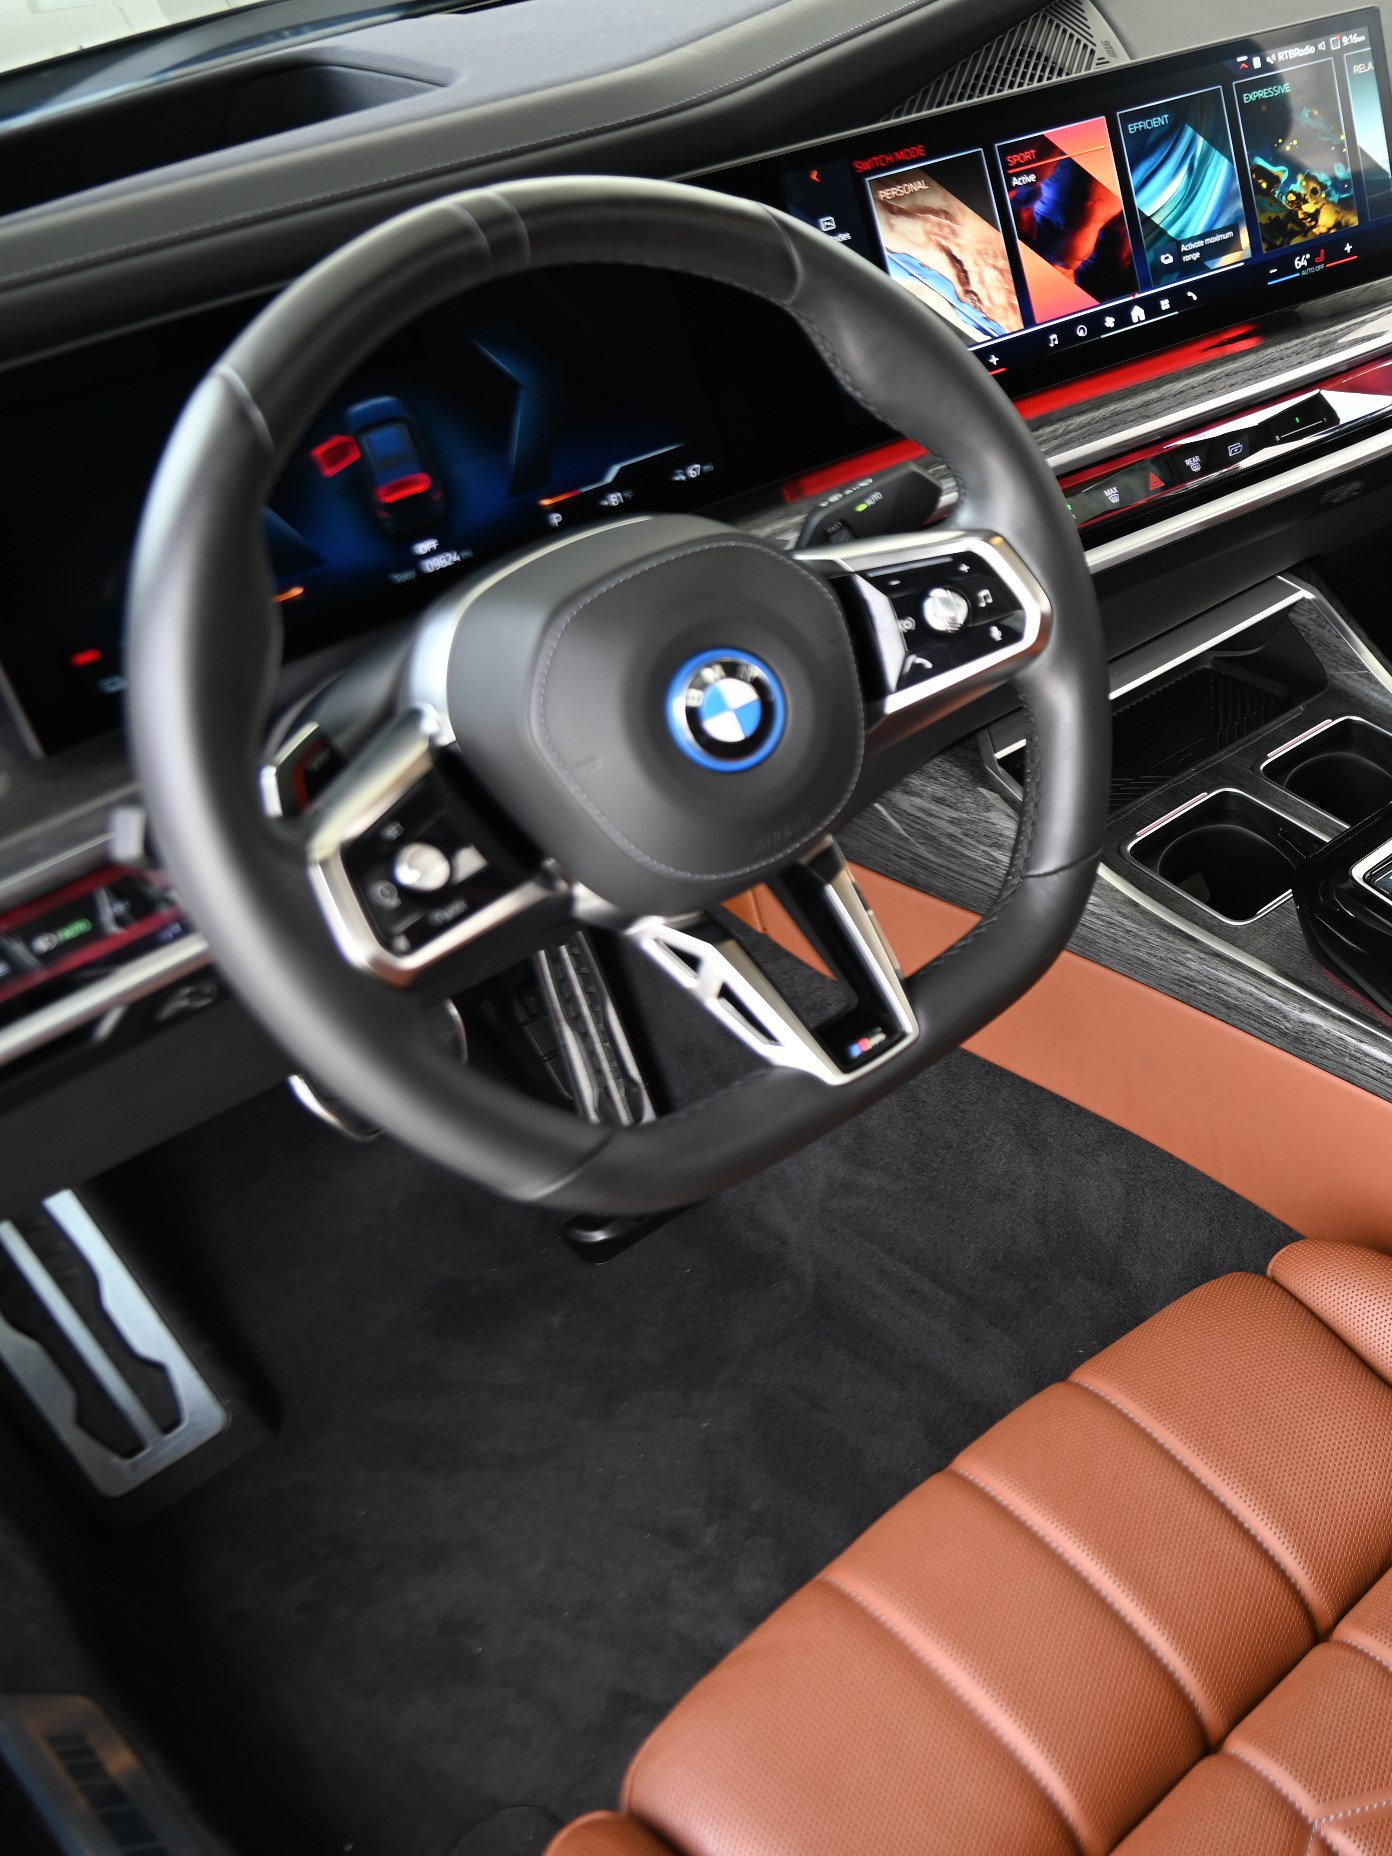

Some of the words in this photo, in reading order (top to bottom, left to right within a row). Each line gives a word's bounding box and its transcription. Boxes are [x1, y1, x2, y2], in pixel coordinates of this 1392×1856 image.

[1243, 83, 1291, 104] EXPRESSIVE
[1128, 114, 1170, 134] EFFICIENT
[853, 153, 893, 173] SWITCH
[894, 144, 927, 163] MODE
[1006, 150, 1037, 167] SPORT
[1012, 173, 1037, 187] Active
[878, 180, 930, 201] PERSONAL
[1181, 240, 1205, 253] Activate
[1205, 231, 1234, 245] maximum
[1182, 252, 1201, 263] range
[1294, 253, 1312, 269] 64°
[1301, 266, 1315, 277] AUTO
[1315, 264, 1326, 273] OFF
[1185, 455, 1201, 466] REAR
[864, 491, 883, 506] AUTO
[1104, 486, 1119, 497] MAX
